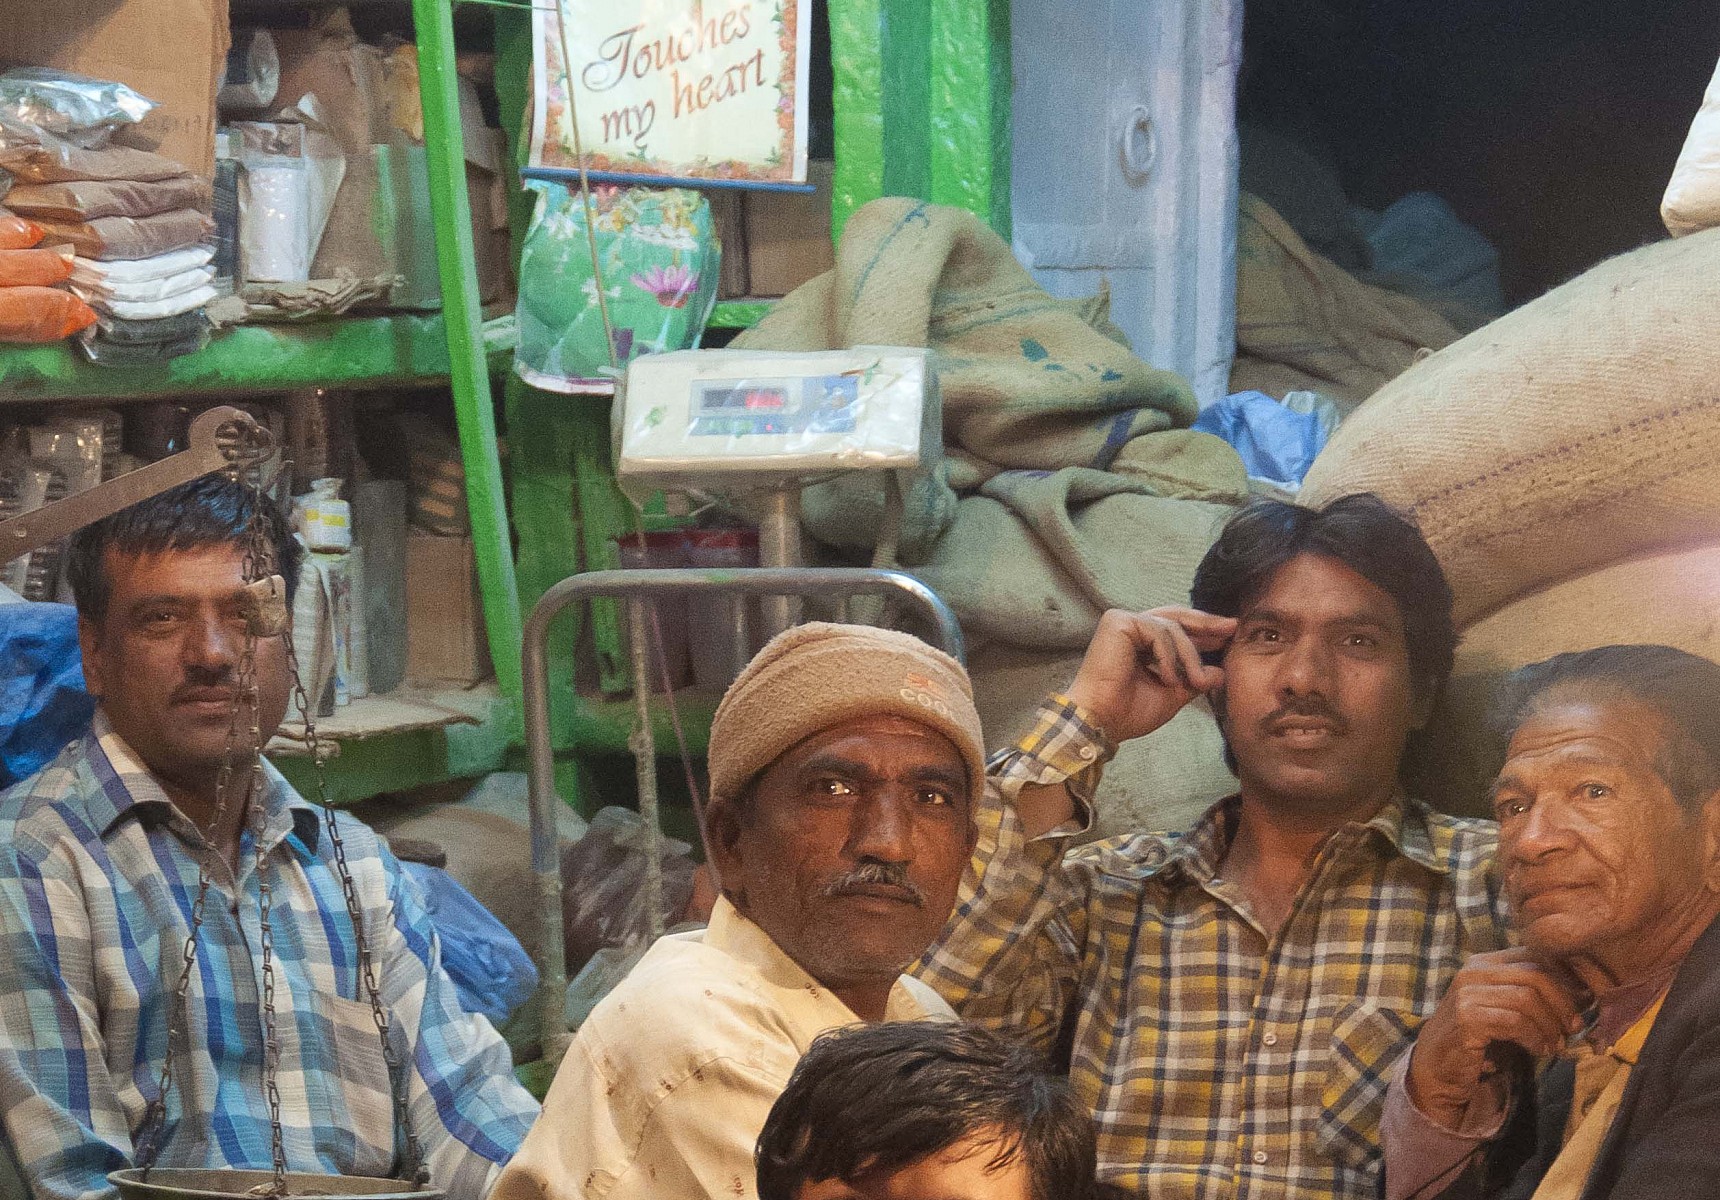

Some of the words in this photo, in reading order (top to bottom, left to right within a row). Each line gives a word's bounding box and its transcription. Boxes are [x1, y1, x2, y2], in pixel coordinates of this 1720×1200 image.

[582, 0, 751, 92] Touches
[601, 98, 656, 149] my
[671, 48, 766, 119] heart
